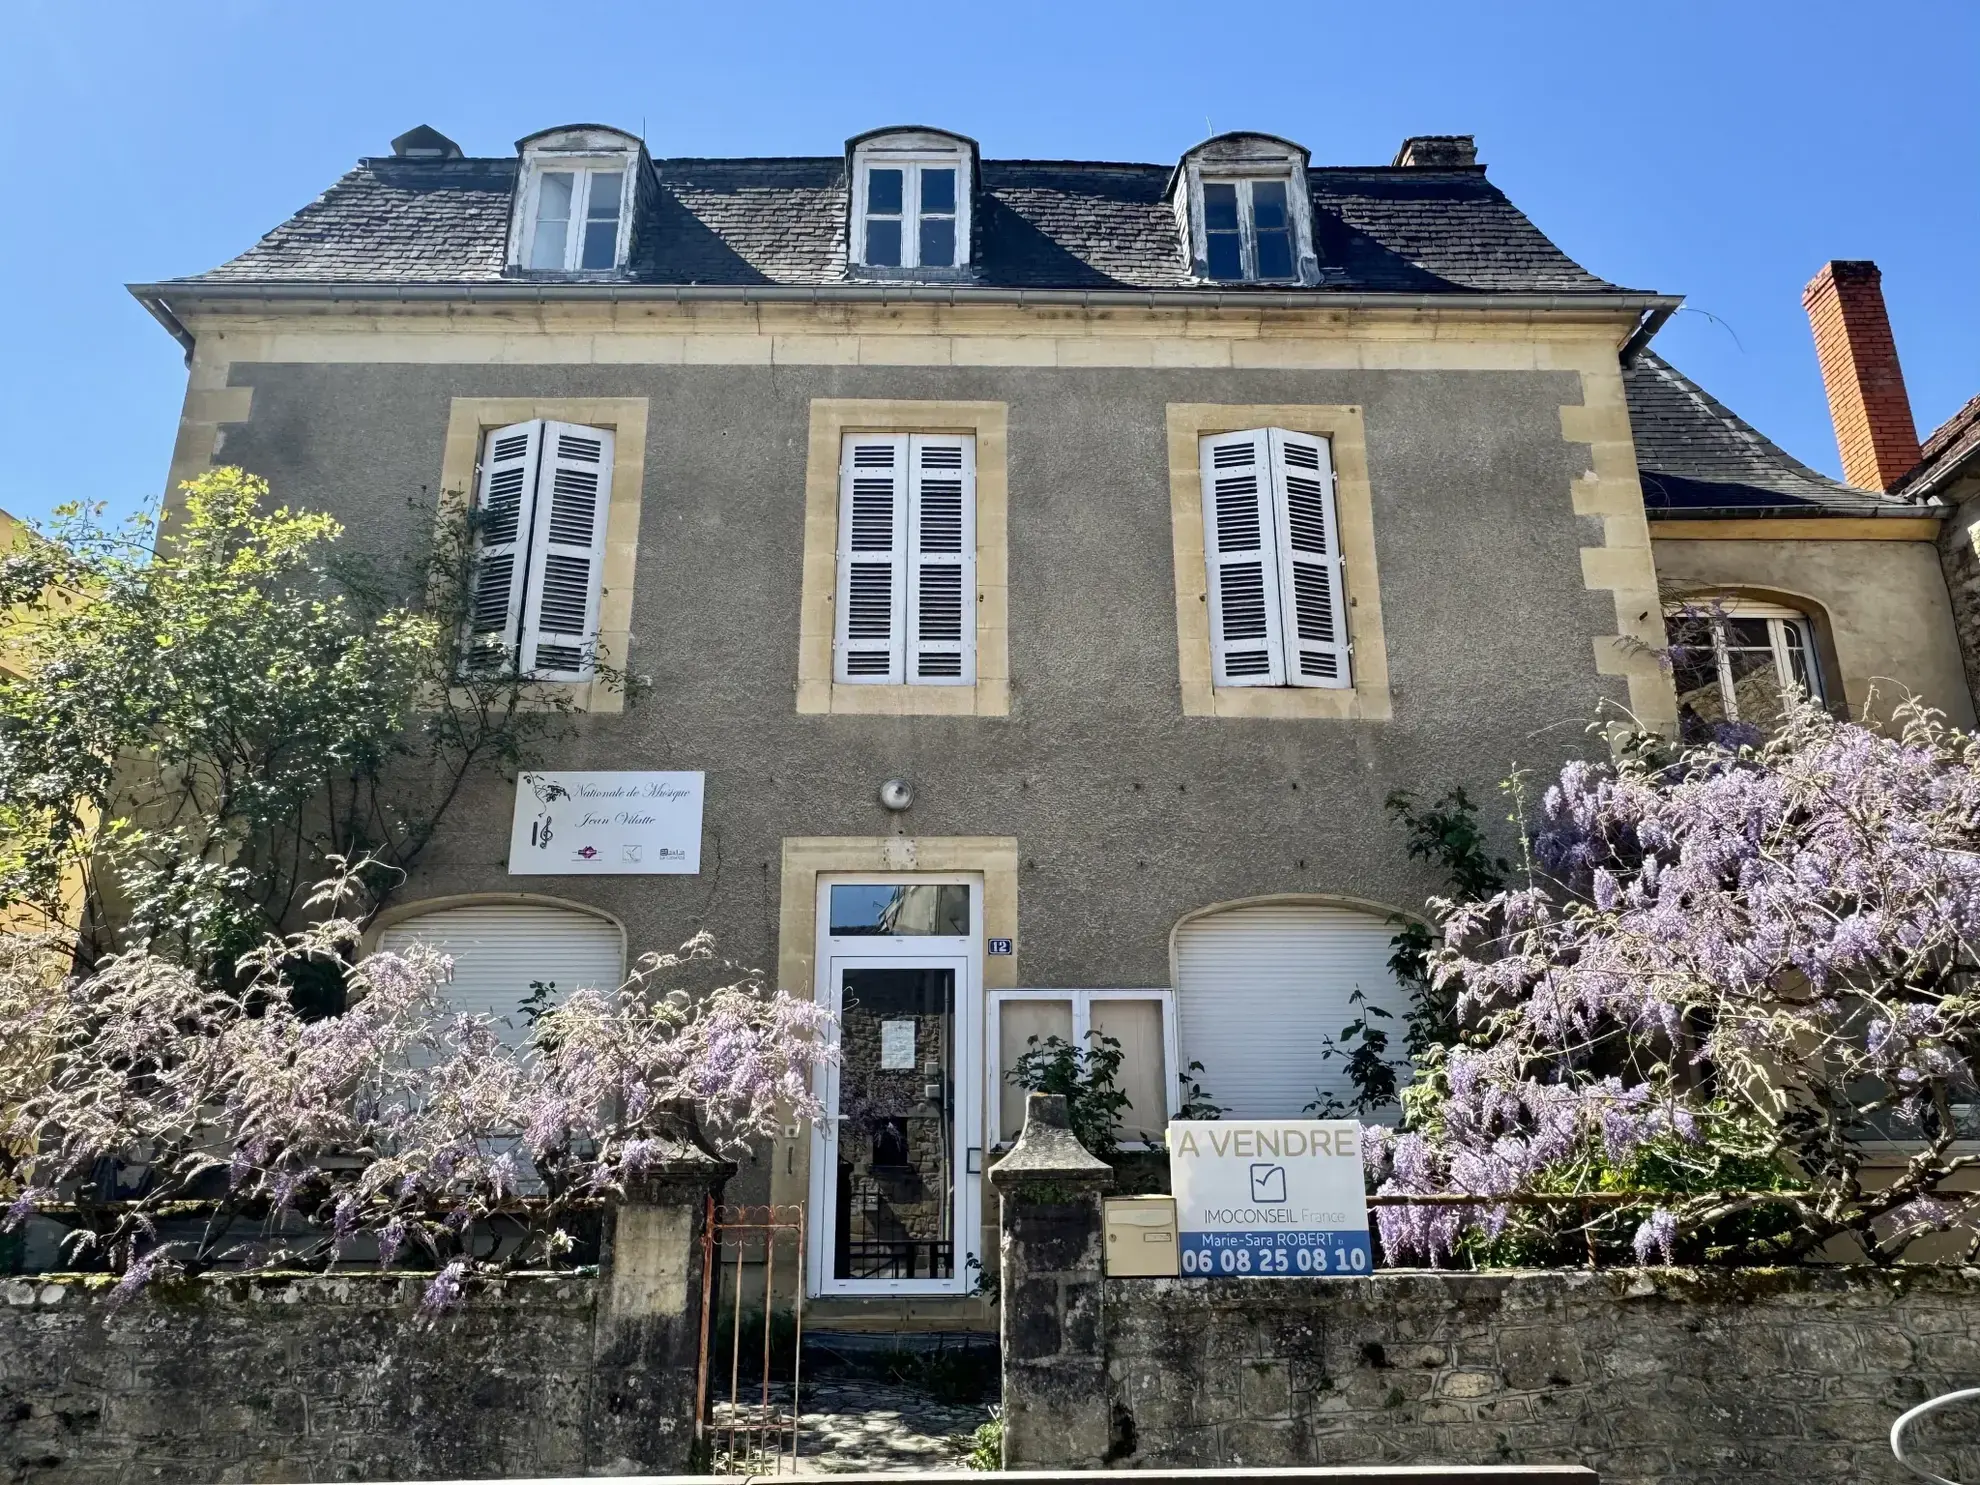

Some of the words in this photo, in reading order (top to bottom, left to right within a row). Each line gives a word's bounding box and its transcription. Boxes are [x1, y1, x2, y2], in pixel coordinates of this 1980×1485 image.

[574, 783, 625, 798] Nationale
[626, 786, 640, 797] de
[642, 782, 691, 802] Musique
[575, 811, 609, 828] Jean
[614, 810, 656, 825] Vilatte
[993, 942, 1007, 952] 12
[1178, 1131, 1200, 1157] A
[1209, 1129, 1355, 1157] VENDRE
[1204, 1208, 1298, 1224] IMOCONSEIL
[1301, 1209, 1345, 1223] France
[1202, 1233, 1273, 1247] Marie-Sara
[1277, 1233, 1334, 1246] ROBERT
[1182, 1250, 1213, 1273] 06
[1220, 1249, 1251, 1273] 08
[1259, 1249, 1288, 1272] 25
[1296, 1248, 1328, 1272] 08
[1335, 1247, 1366, 1271] 10
